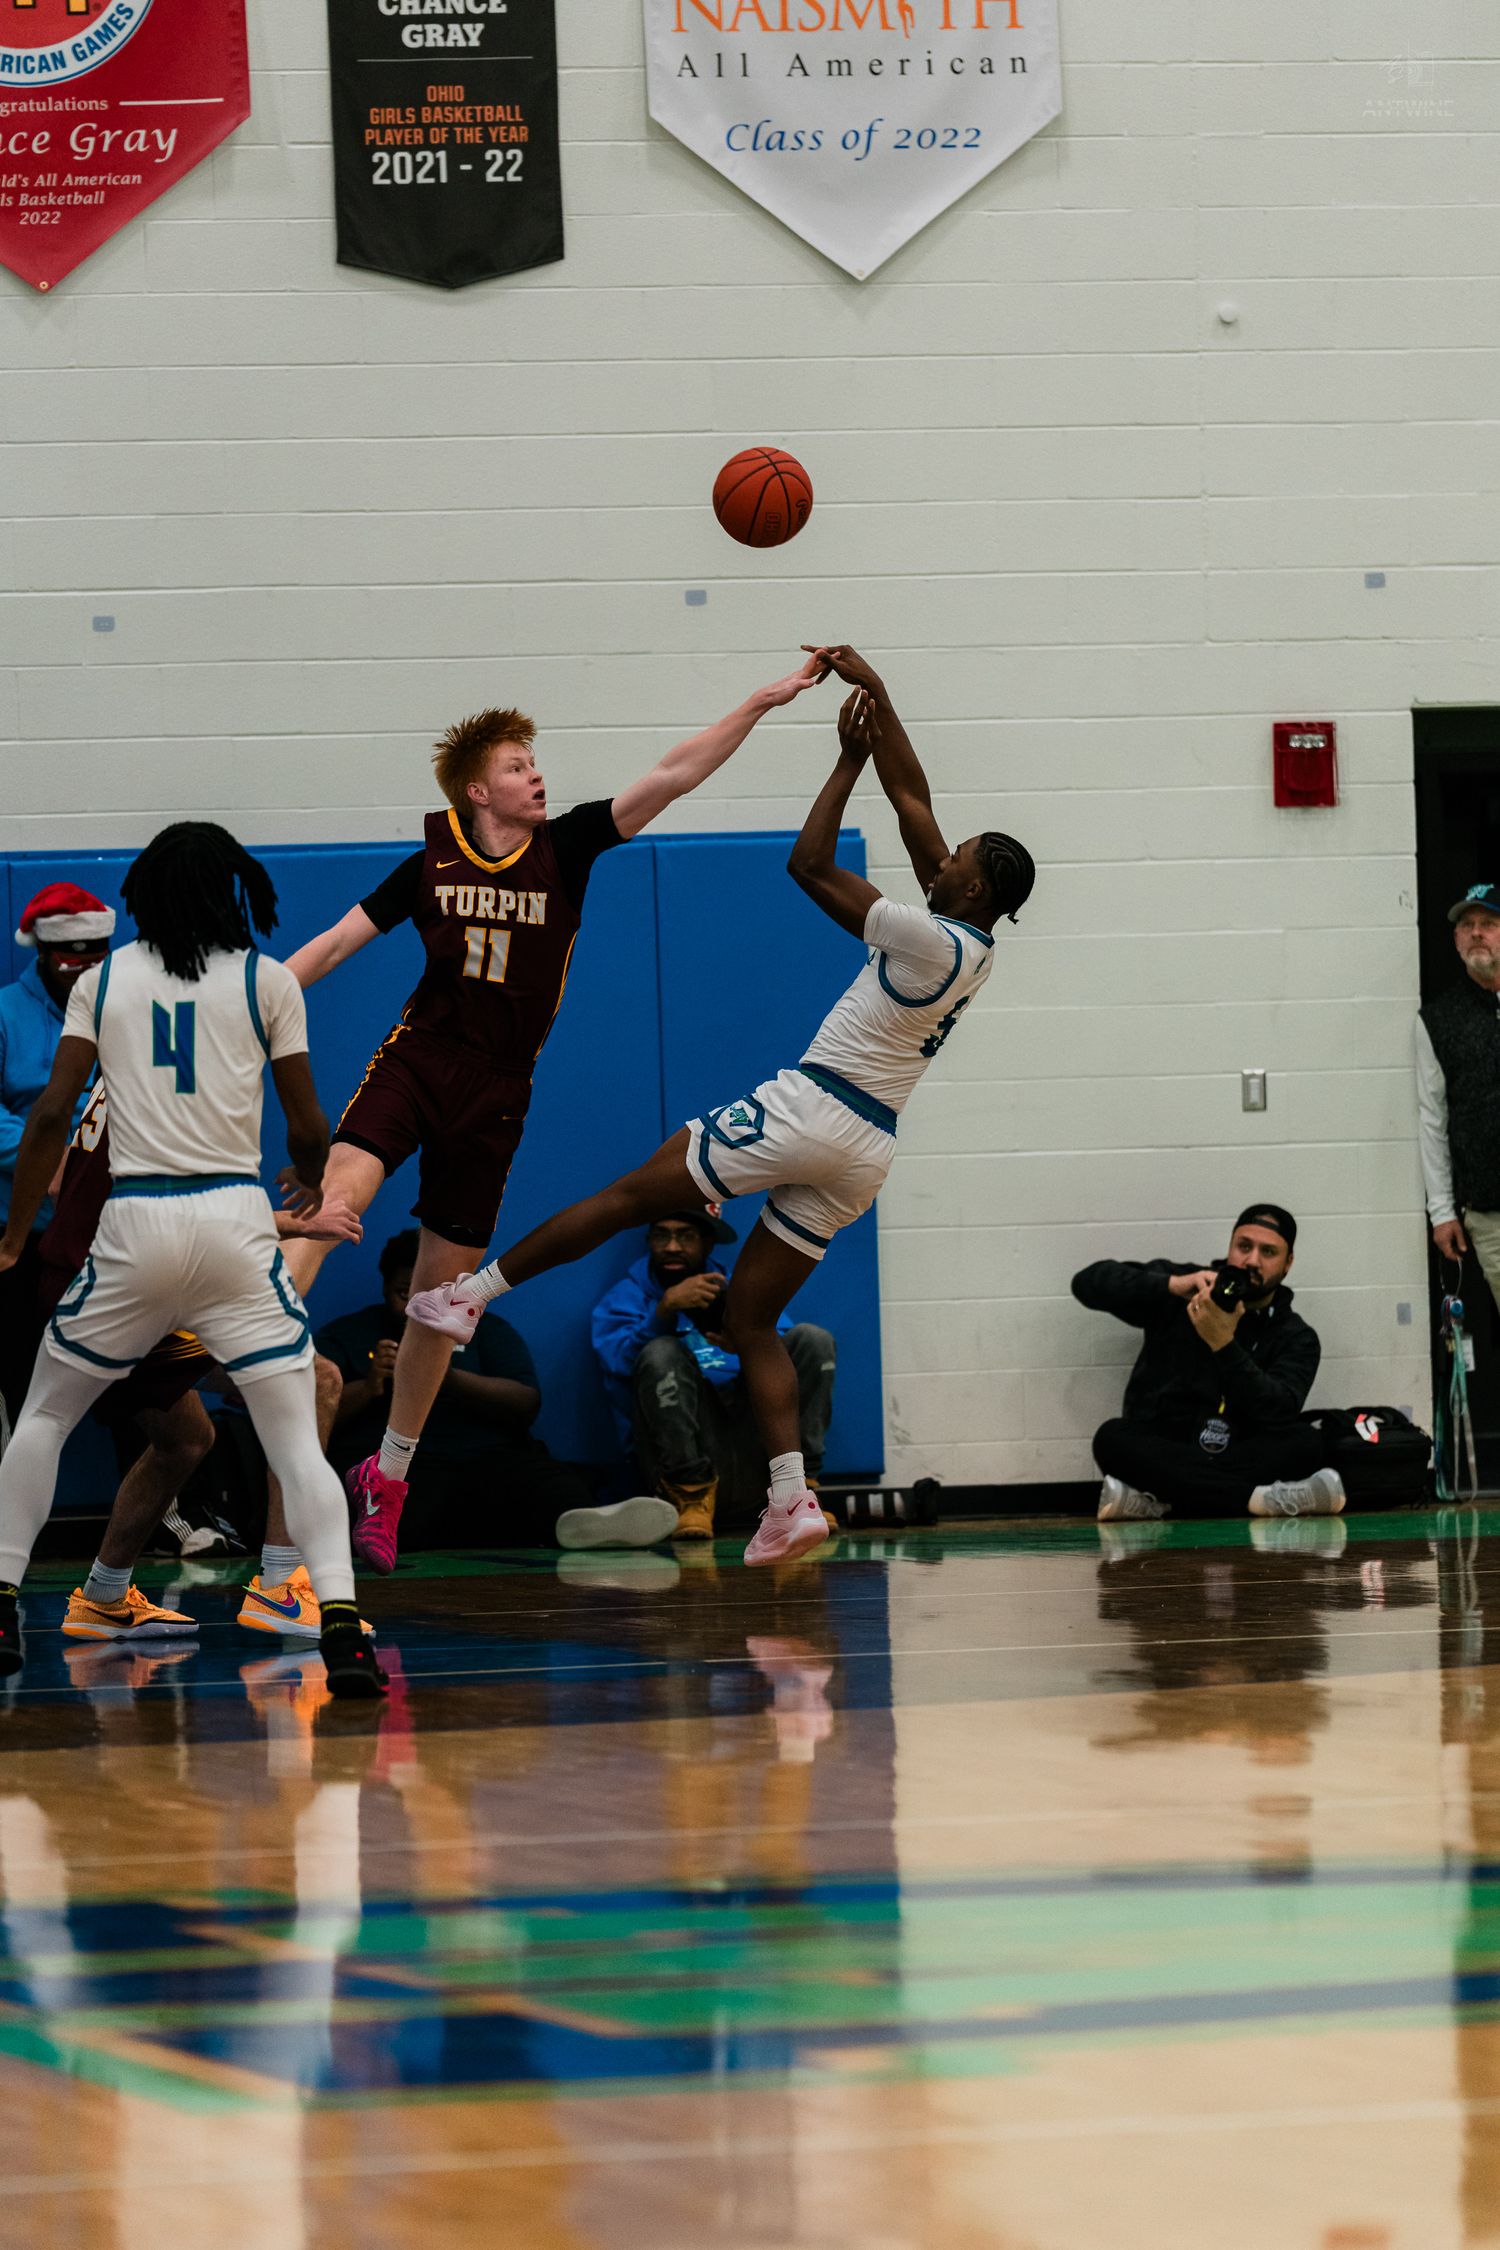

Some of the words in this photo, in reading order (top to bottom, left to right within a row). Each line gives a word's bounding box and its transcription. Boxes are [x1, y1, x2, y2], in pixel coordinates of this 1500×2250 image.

[378, 0, 507, 16] CHANCE
[71, 3, 134, 62] GAMES
[401, 23, 485, 49] GRAY
[677, 53, 748, 77] All
[787, 51, 1028, 77] American
[426, 85, 464, 102] OHIO
[0, 97, 109, 117] gratulations
[370, 107, 415, 125] GIRLS
[421, 105, 523, 123] BASKETBALL
[0, 130, 50, 155] ce
[69, 122, 178, 163] Gray
[365, 128, 423, 145] PLAYER
[430, 127, 449, 143] OF
[453, 127, 484, 143] THE
[488, 126, 529, 143] YEAR
[726, 119, 823, 152] Class
[841, 118, 883, 161] of
[893, 127, 981, 149] 2022
[34, 173, 57, 187] All
[62, 172, 142, 187] American
[372, 150, 448, 185] 2021
[485, 149, 523, 183] 22
[19, 190, 105, 207] Basketball
[19, 210, 61, 225] 2022
[435, 885, 547, 925] TURPIN
[463, 926, 511, 983] 11
[152, 999, 196, 1095] 4
